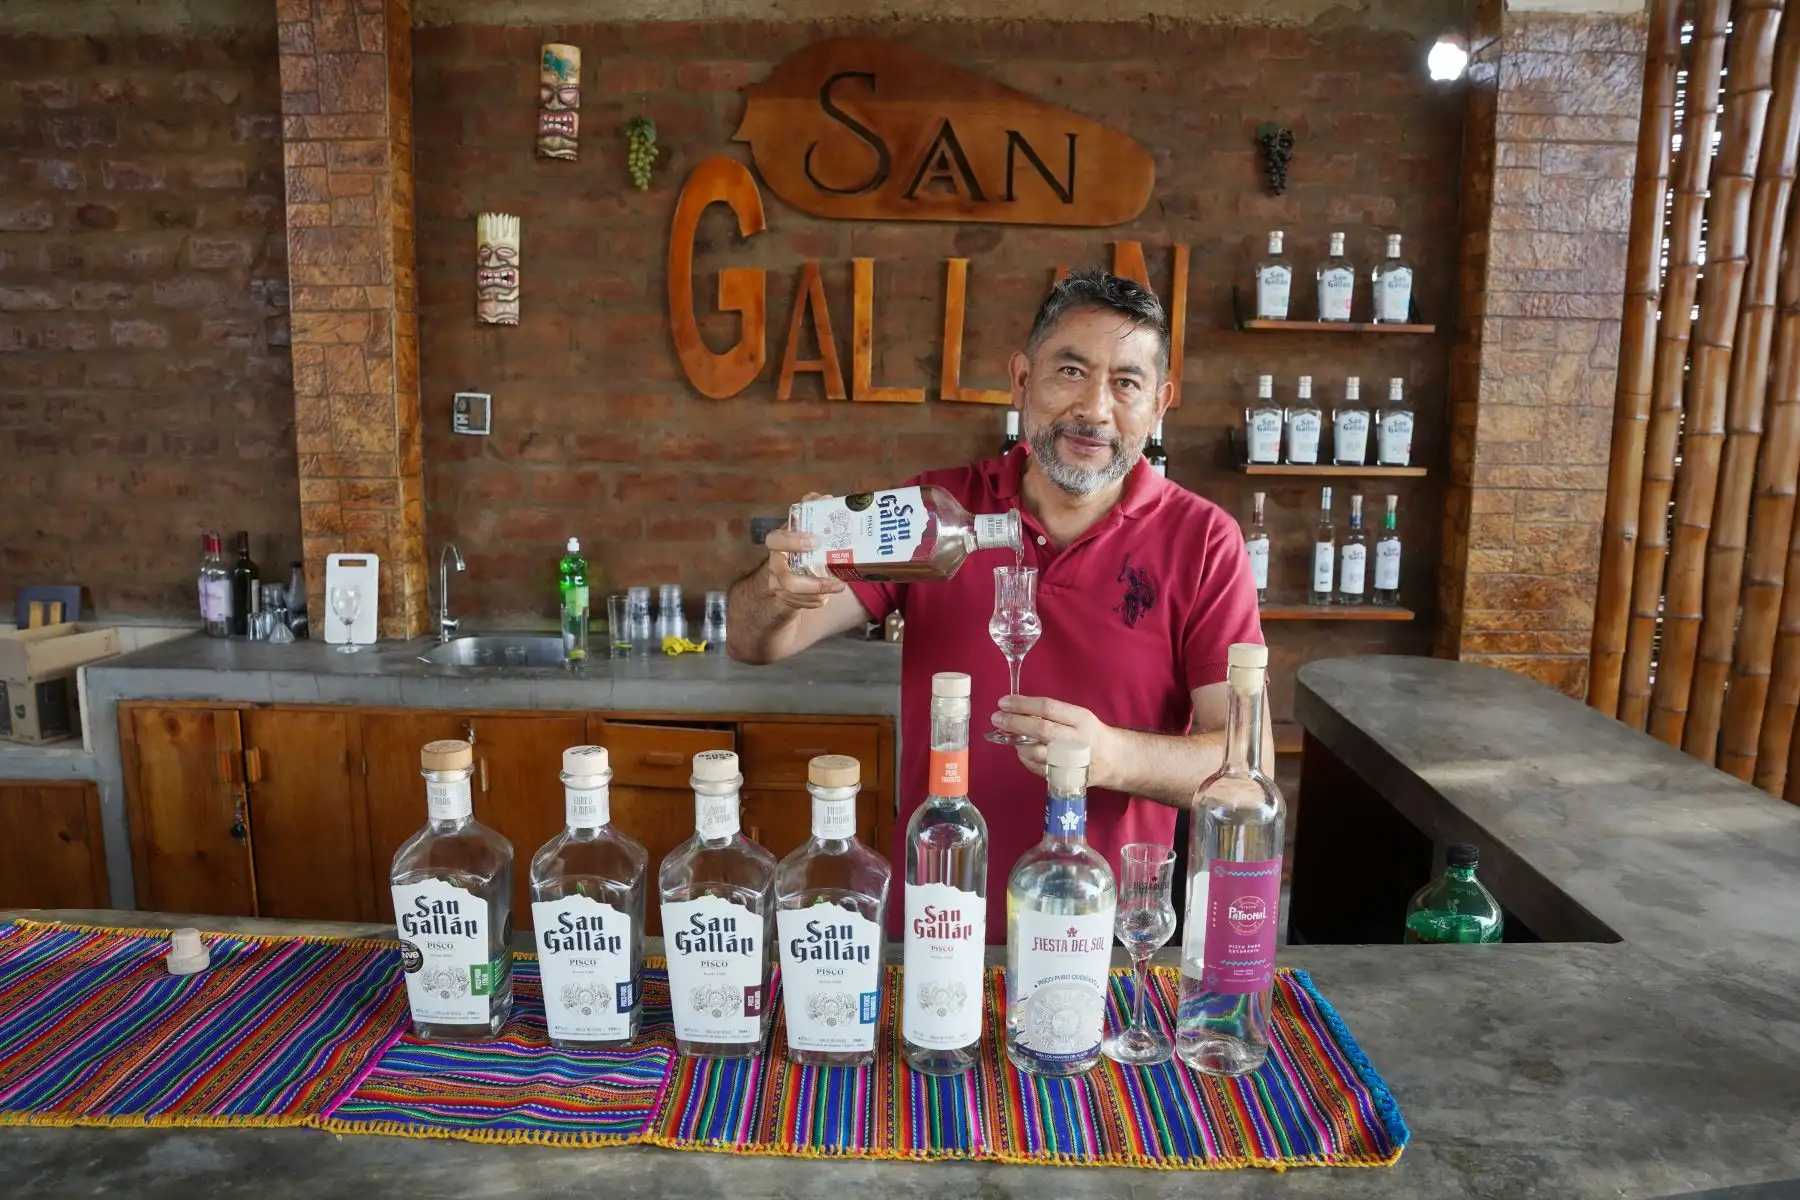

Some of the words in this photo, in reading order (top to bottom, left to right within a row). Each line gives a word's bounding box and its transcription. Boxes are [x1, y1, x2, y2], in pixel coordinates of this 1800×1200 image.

[804, 71, 1079, 204] SAN
[668, 156, 1190, 408] GALLN
[876, 494, 898, 556] Gallán
[894, 504, 914, 540] San
[414, 895, 460, 918] San
[924, 905, 961, 924] San
[402, 913, 478, 939] Gallán
[557, 911, 604, 935] San
[689, 912, 736, 937] San
[806, 919, 853, 943] San
[913, 918, 972, 941] Gallán
[427, 942, 455, 950] PISCO
[543, 929, 622, 956] Gallán
[675, 930, 755, 957] Gallán
[790, 938, 870, 965] Gallán
[1032, 936, 1068, 951] FIESTA
[1071, 939, 1090, 953] DEL
[1090, 936, 1104, 951] SOL
[816, 968, 844, 976] PISCO
